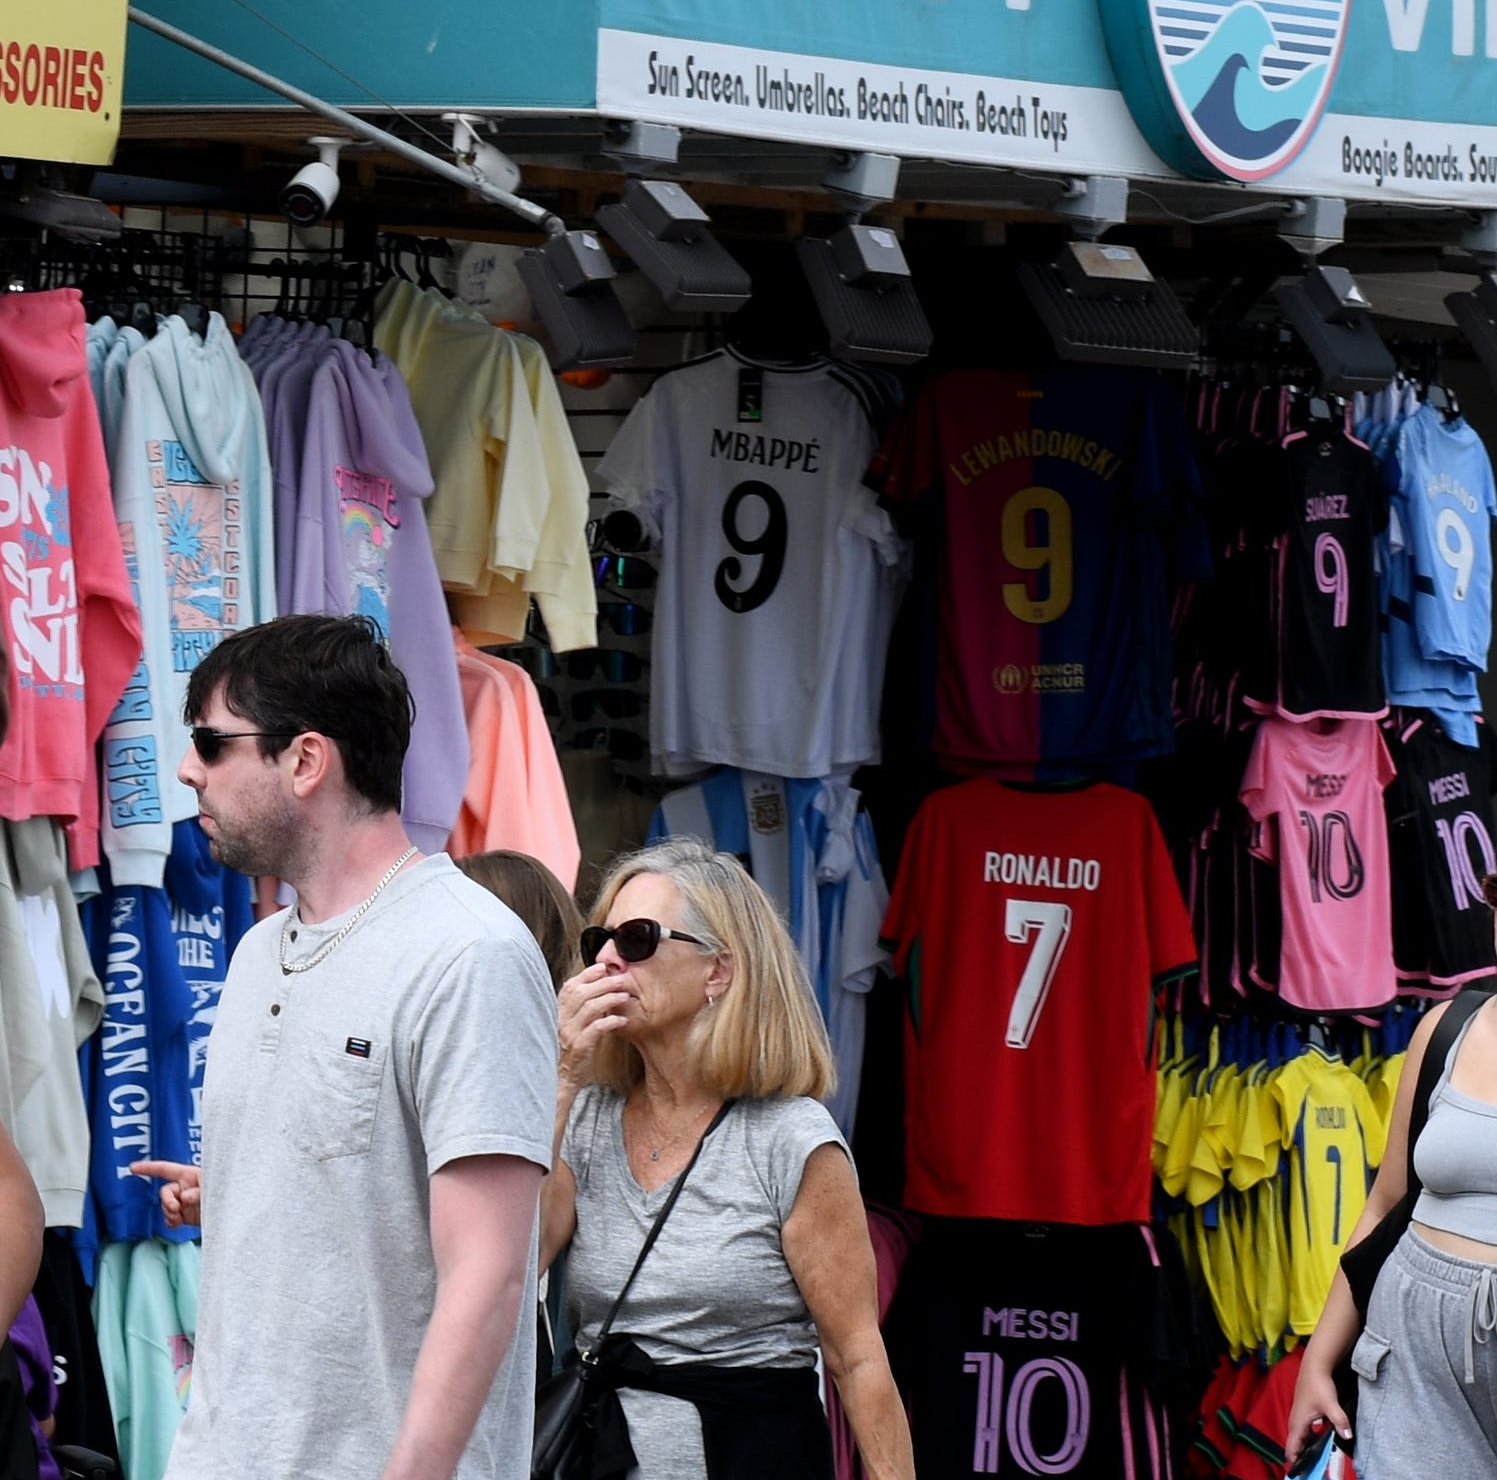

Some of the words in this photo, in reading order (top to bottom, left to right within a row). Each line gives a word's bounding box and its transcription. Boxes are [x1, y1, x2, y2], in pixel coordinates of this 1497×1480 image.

[649, 51, 678, 96] Sun
[858, 78, 908, 123] Beach
[977, 91, 1026, 137] Beach
[1032, 97, 1067, 151] Toys
[1342, 136, 1398, 186] Boogie
[711, 428, 821, 473] MBAPPÉ
[950, 428, 1123, 486] LEWANDOWSKI
[715, 480, 787, 613] 9
[1001, 486, 1073, 623] 9
[1314, 532, 1349, 628] 9
[1436, 508, 1474, 602] 9
[1032, 663, 1084, 676] UNHCR
[1032, 676, 1085, 688] ACNUR
[1428, 772, 1470, 805] MESSI
[984, 851, 1101, 892] RONALDO
[1299, 810, 1365, 903] 10
[1435, 811, 1497, 911] 10
[105, 931, 147, 1079] OCEAN
[1005, 900, 1072, 1050] 7
[983, 1306, 1079, 1341] MESSI
[963, 1351, 1090, 1476] 10
